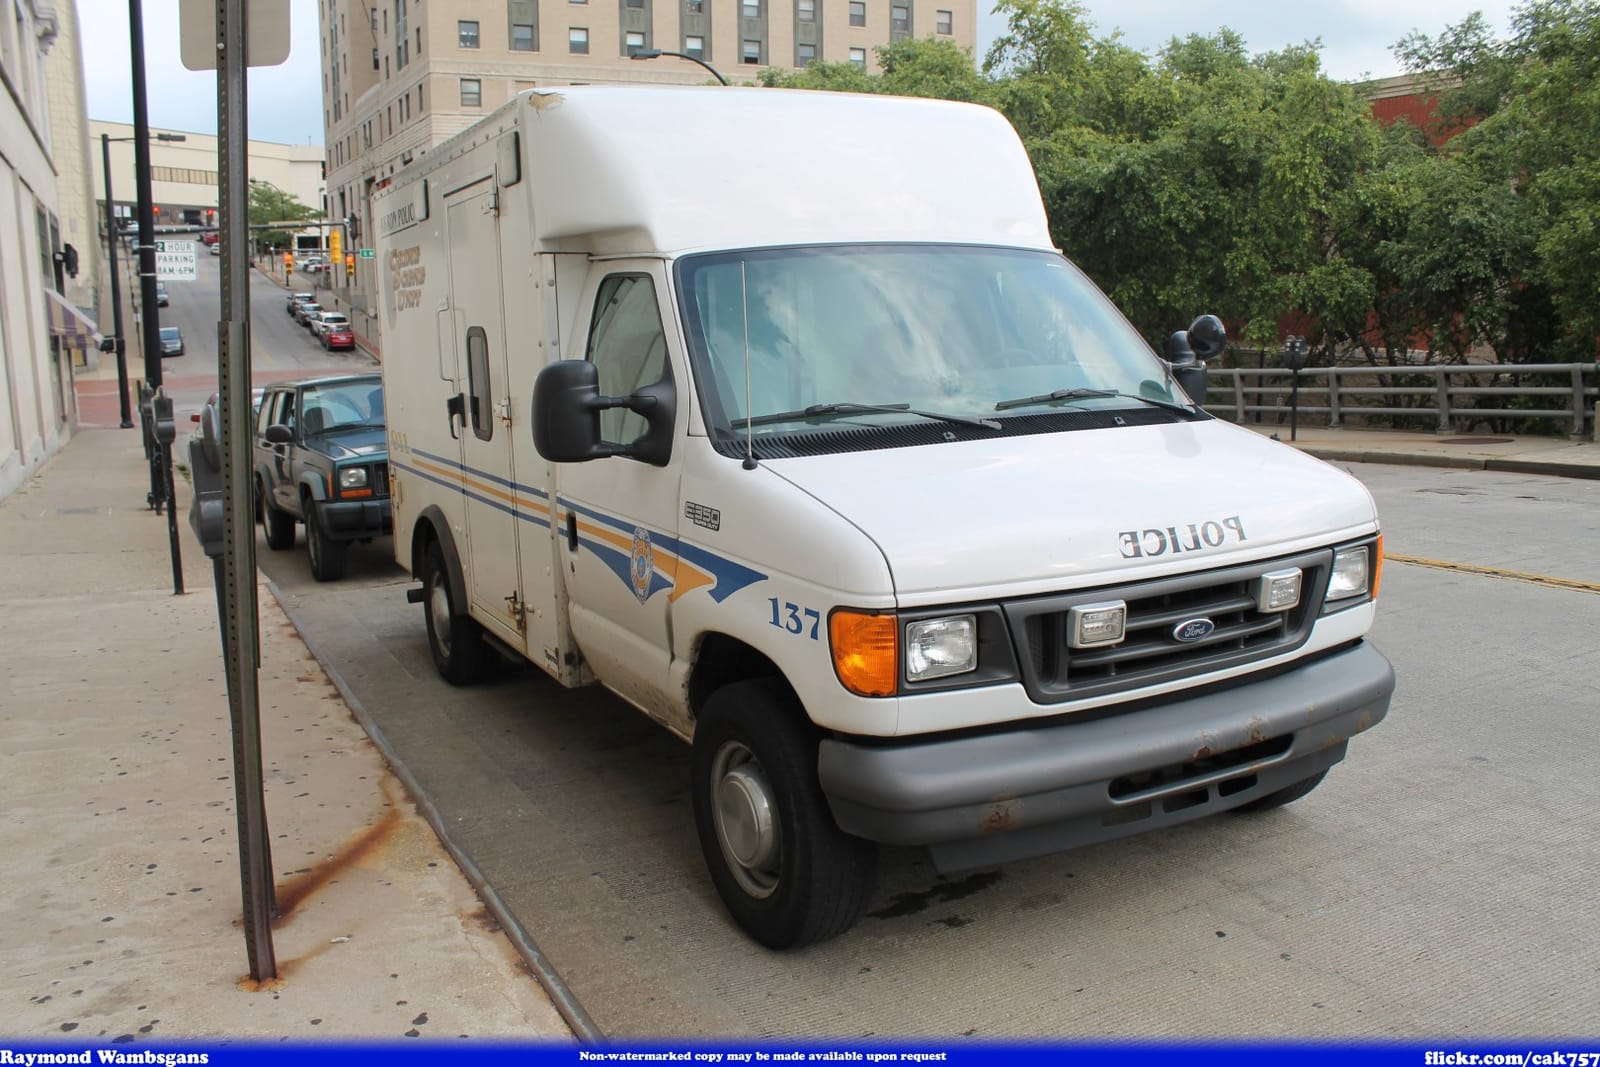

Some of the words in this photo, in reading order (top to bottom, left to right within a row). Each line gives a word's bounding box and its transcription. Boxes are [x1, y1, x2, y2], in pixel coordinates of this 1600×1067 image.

[397, 202, 416, 228] POLIC
[156, 242, 164, 252] 2
[168, 242, 192, 251] HOUR
[157, 255, 194, 264] PARKING
[768, 596, 820, 641] 137
[1184, 623, 1206, 637] Ford
